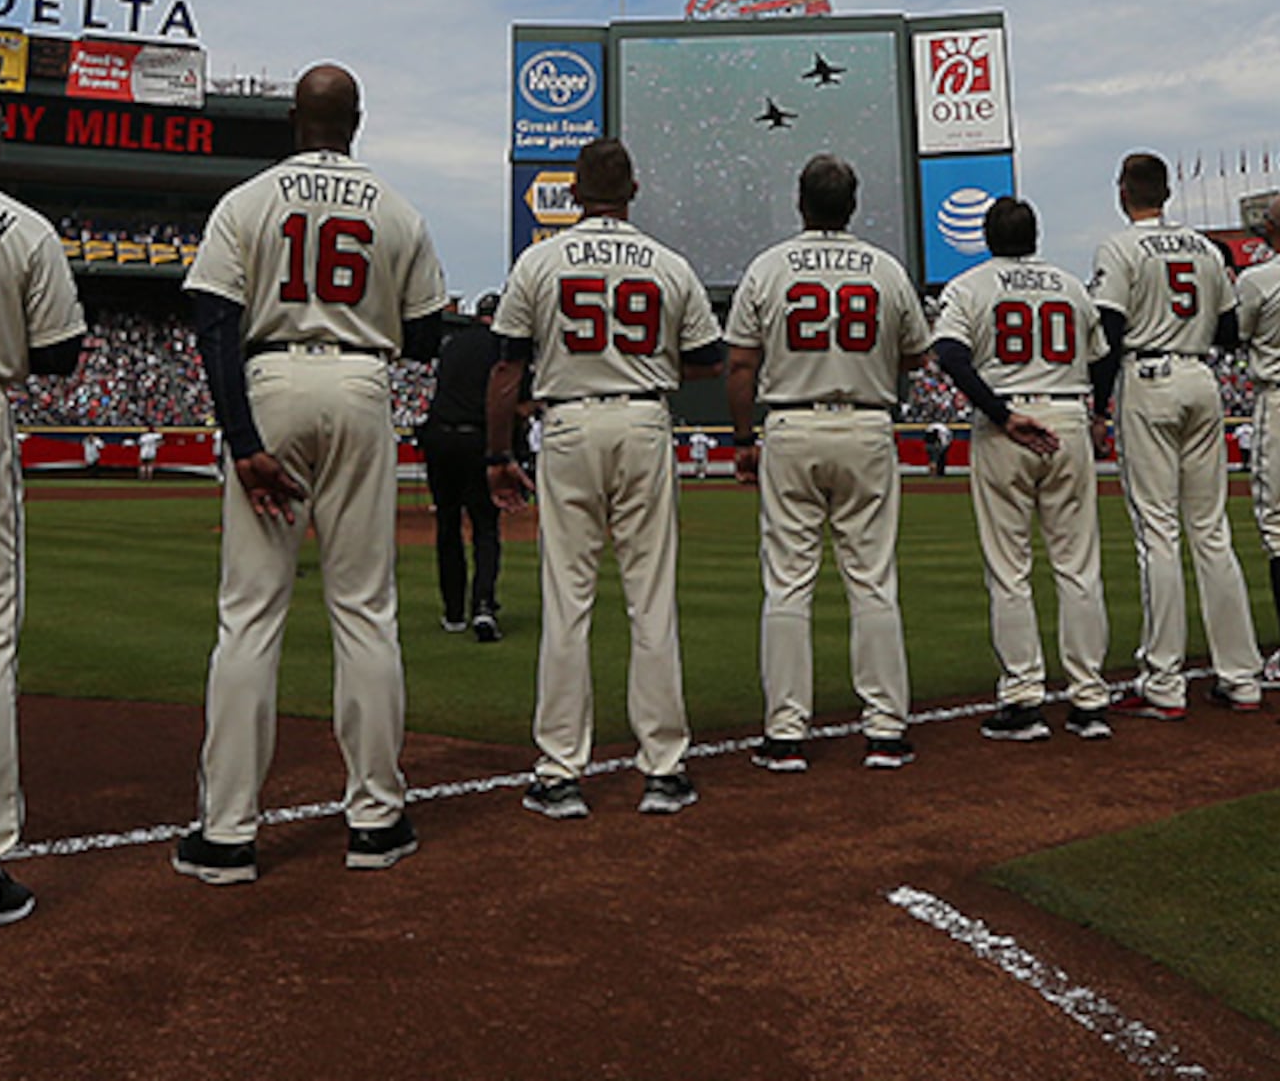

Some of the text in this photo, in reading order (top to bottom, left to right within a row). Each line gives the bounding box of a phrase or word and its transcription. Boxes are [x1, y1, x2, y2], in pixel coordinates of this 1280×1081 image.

[529, 60, 589, 104] Kroger
[65, 109, 215, 154] MILLER
[932, 99, 995, 123] one
[279, 174, 378, 208] PORTER
[280, 213, 374, 305] 16
[566, 240, 654, 267] CASTRO
[788, 249, 874, 274] SEITZER
[1139, 234, 1208, 257] FREEMAN
[997, 270, 1064, 292] MOSES
[1166, 261, 1197, 319] 5
[560, 277, 662, 355] 59
[786, 282, 880, 352] 28
[993, 299, 1076, 365] 80
